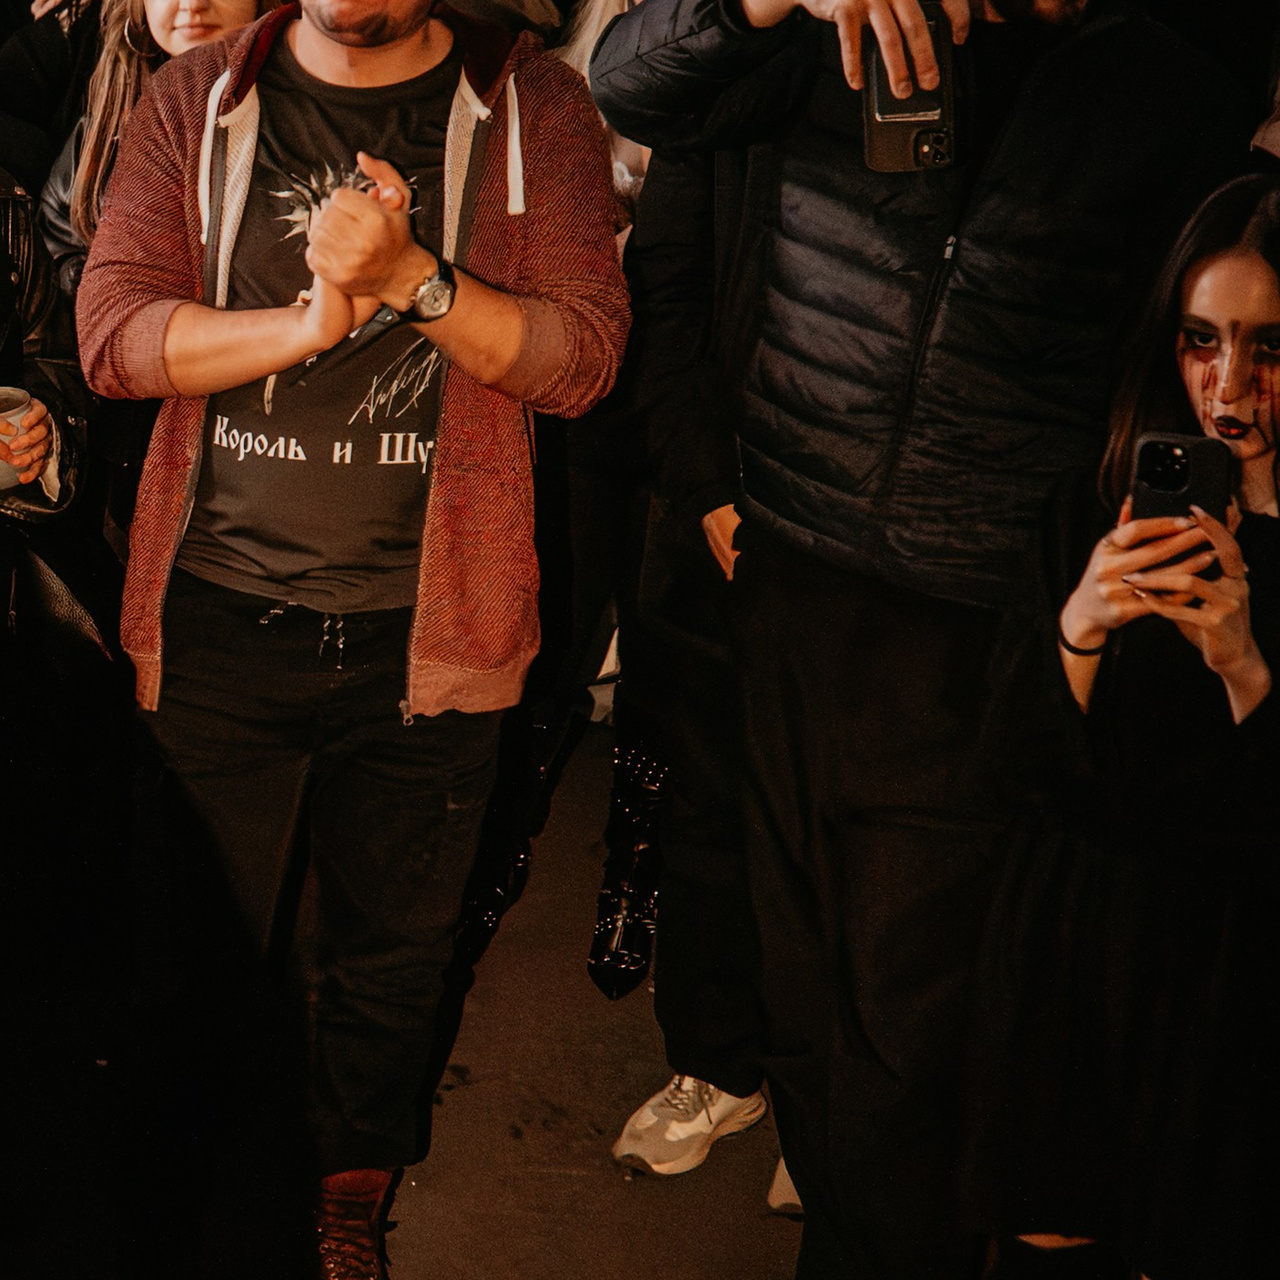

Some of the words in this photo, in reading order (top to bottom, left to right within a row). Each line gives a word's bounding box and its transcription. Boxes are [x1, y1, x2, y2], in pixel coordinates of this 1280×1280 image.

[213, 414, 307, 461] Король
[332, 440, 353, 464] и
[377, 432, 434, 474] Шу
